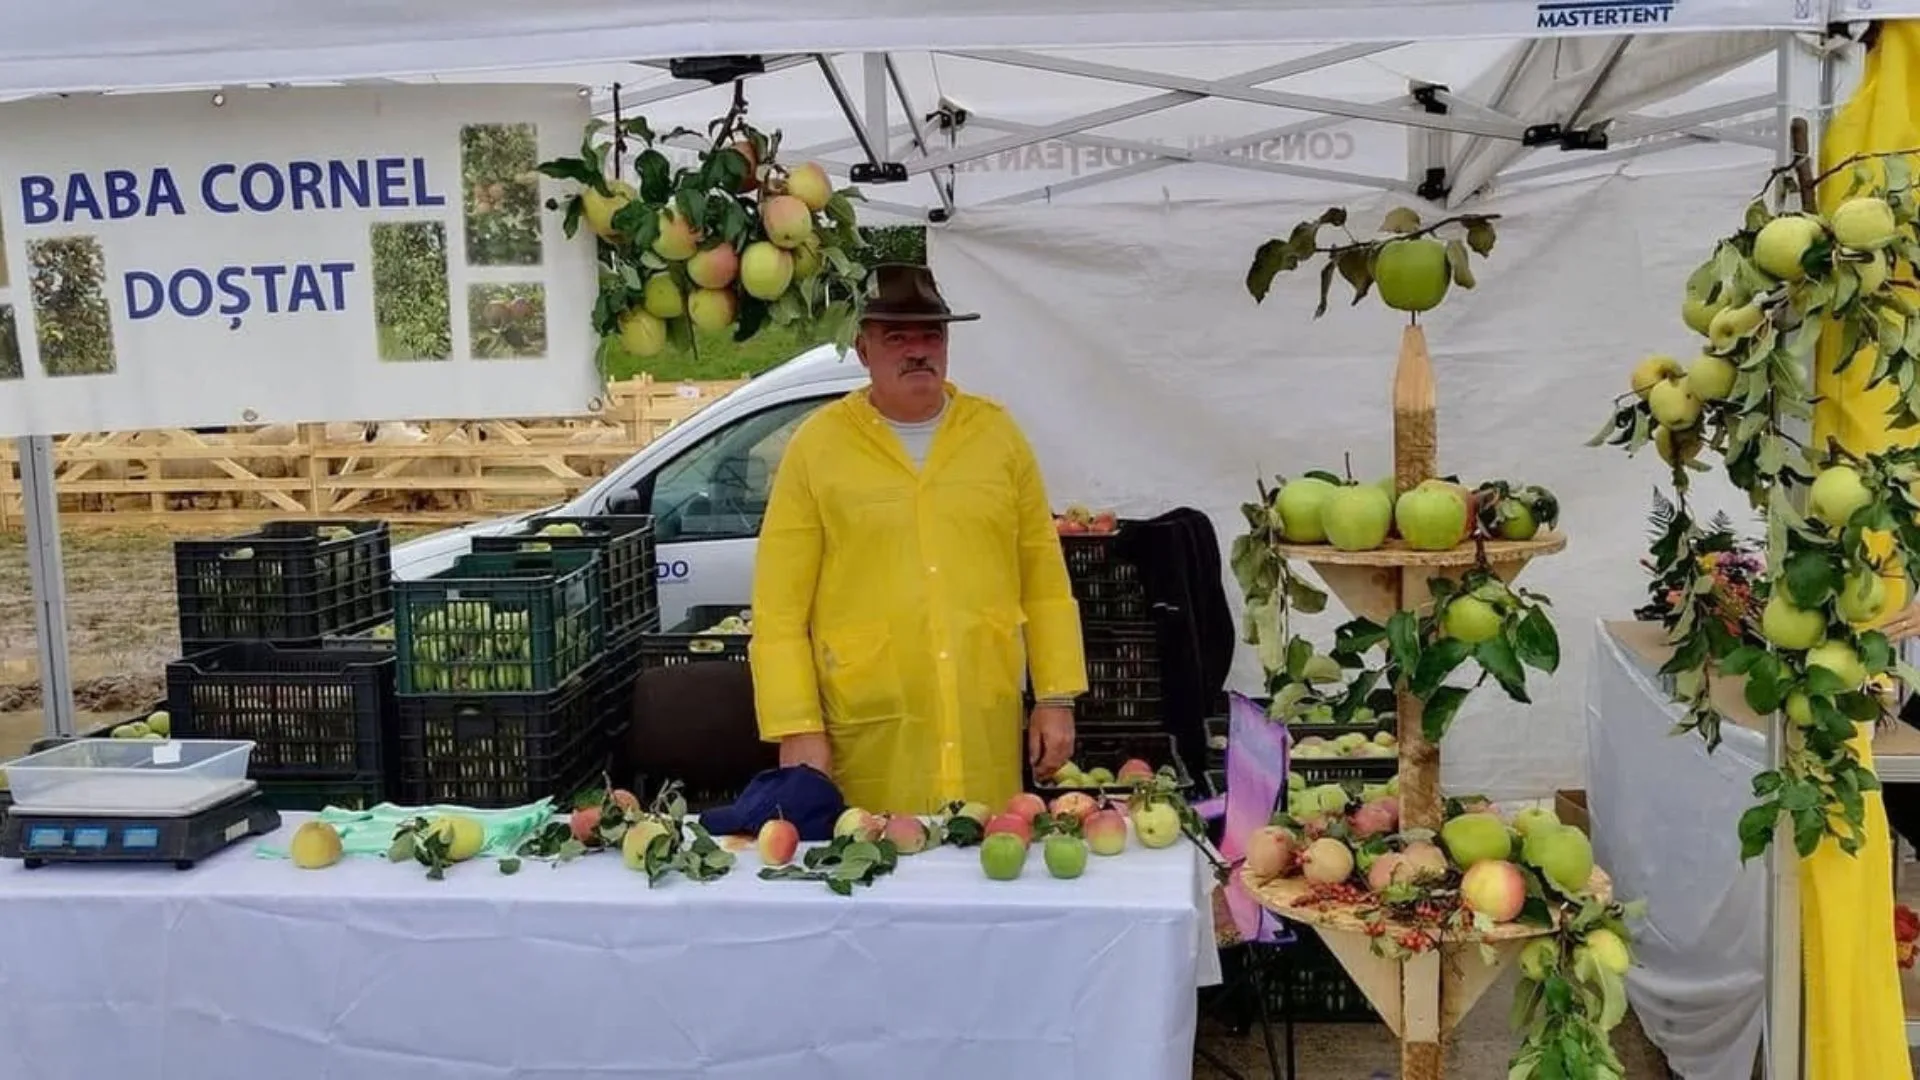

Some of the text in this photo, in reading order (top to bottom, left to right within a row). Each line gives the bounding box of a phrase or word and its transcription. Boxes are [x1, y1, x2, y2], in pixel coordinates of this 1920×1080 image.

[1537, 6, 1673, 27] MASTERTENT
[20, 157, 445, 225] BABA CORNEL
[124, 263, 355, 330] DOȘTAT
